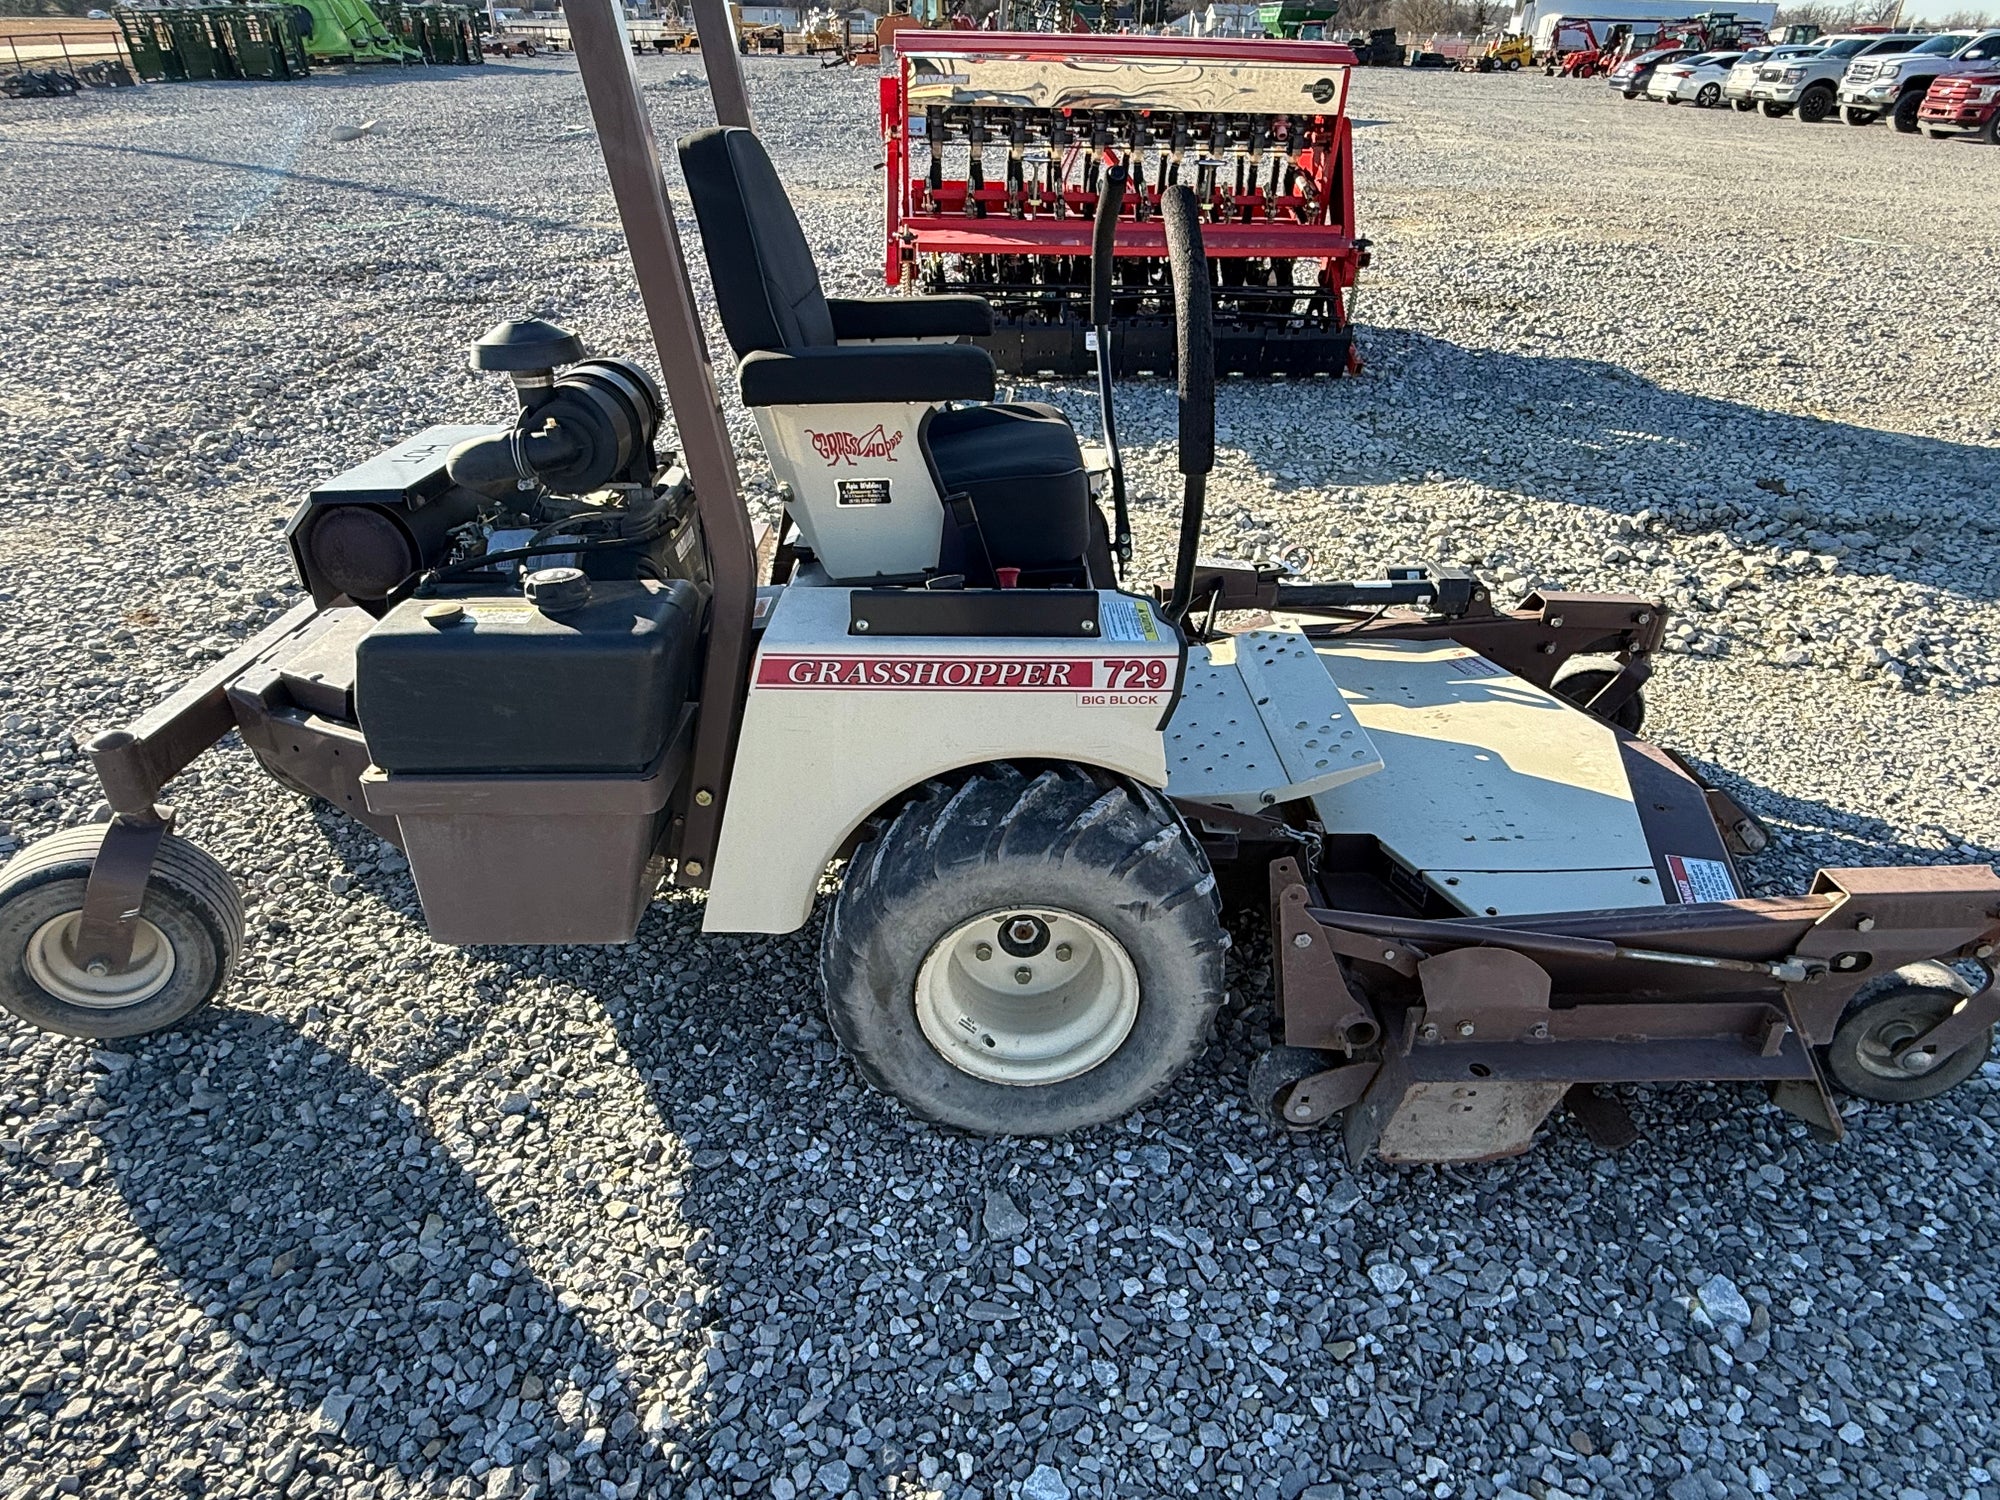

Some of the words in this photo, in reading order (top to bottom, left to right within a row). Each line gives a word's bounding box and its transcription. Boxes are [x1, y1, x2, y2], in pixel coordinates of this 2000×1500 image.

[809, 426, 905, 463] GRASSHOPPER
[788, 661, 1072, 686] GRASSHOPPER
[1104, 660, 1167, 689] 729
[1082, 695, 1105, 705] BIG
[1110, 695, 1158, 705] BLOCK
